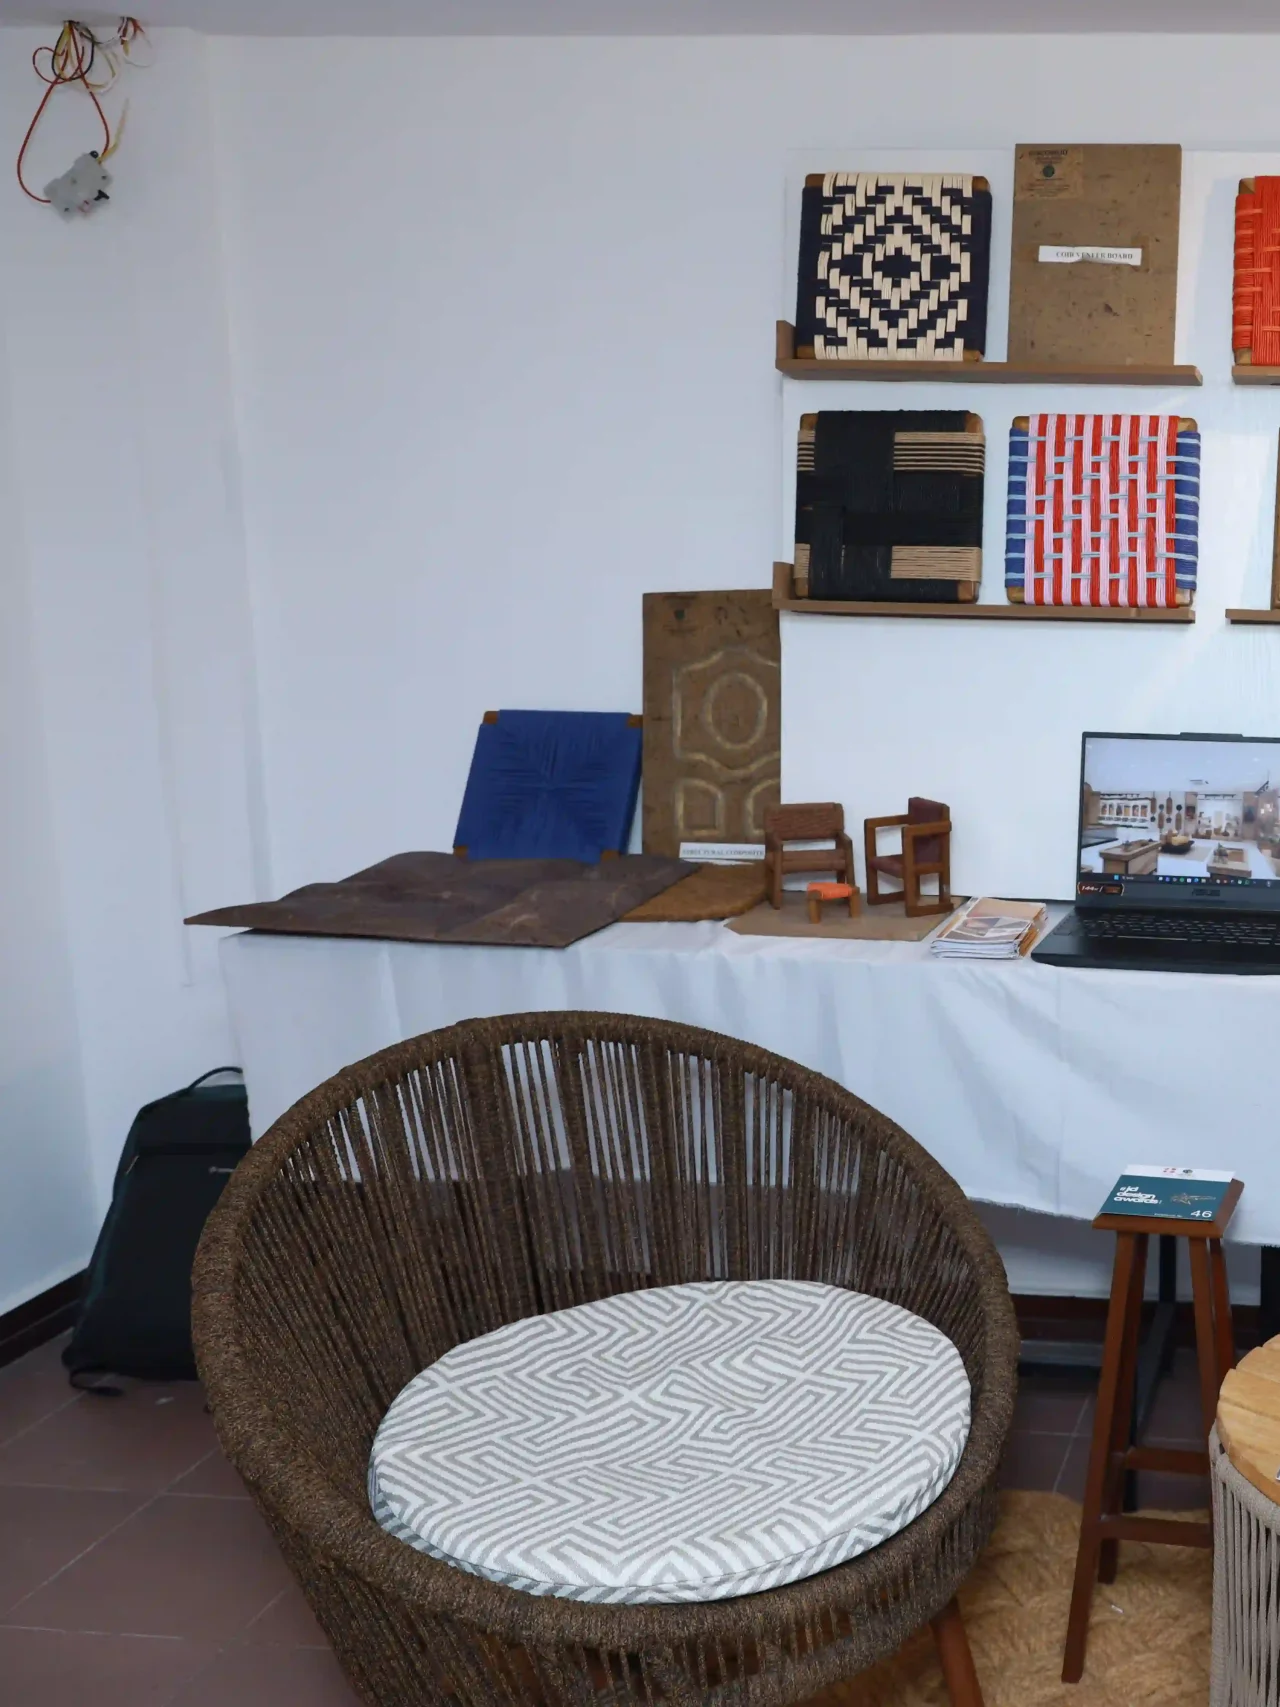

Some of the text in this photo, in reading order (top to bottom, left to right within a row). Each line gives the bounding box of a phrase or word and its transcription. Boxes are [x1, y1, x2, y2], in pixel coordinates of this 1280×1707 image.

[1107, 252, 1133, 260] BOARD
[1117, 1192, 1156, 1200] design
[1190, 1210, 1213, 1218] 46
